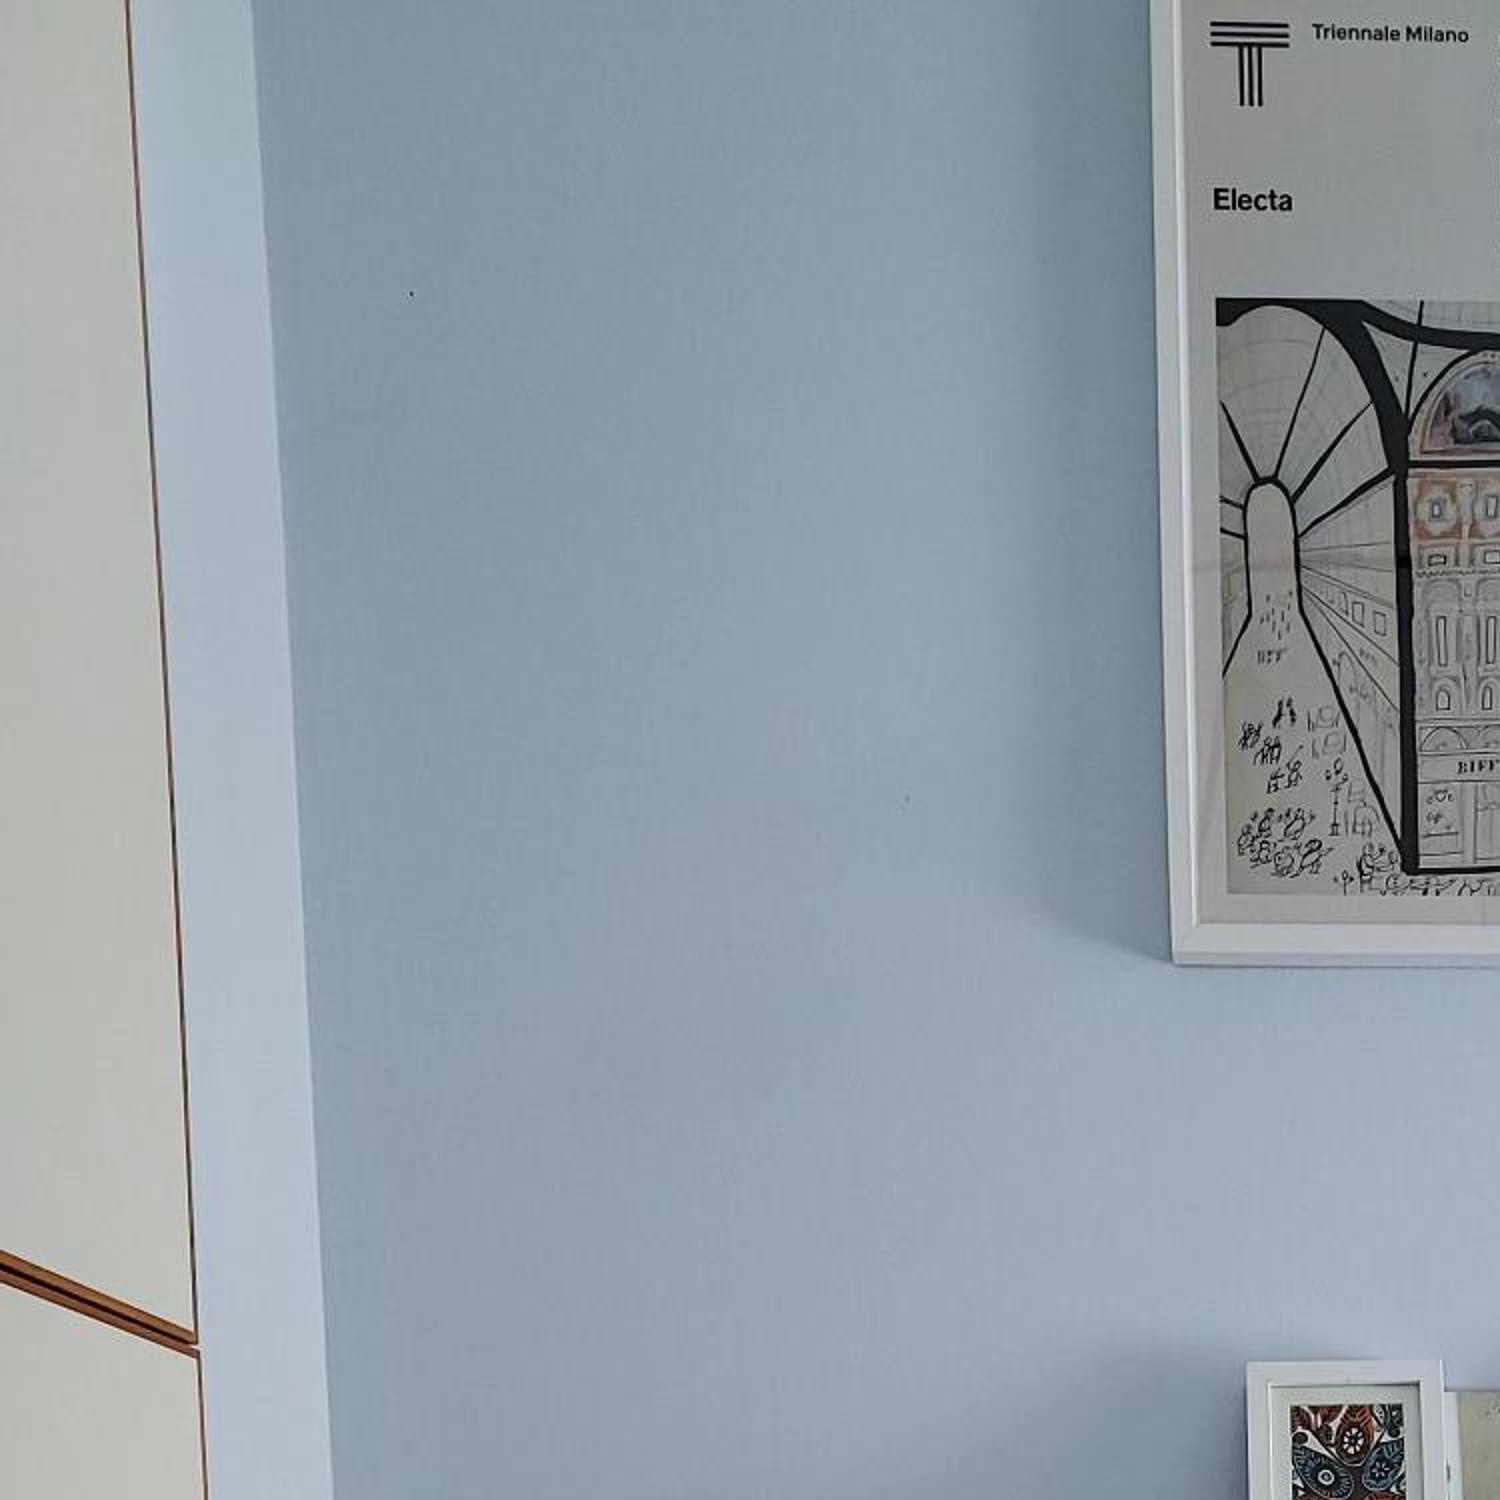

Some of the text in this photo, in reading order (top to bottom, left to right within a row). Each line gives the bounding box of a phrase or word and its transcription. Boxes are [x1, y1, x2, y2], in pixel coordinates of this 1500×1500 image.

[1311, 23, 1470, 43] Triennale Milano
[1212, 187, 1293, 212] Electa
